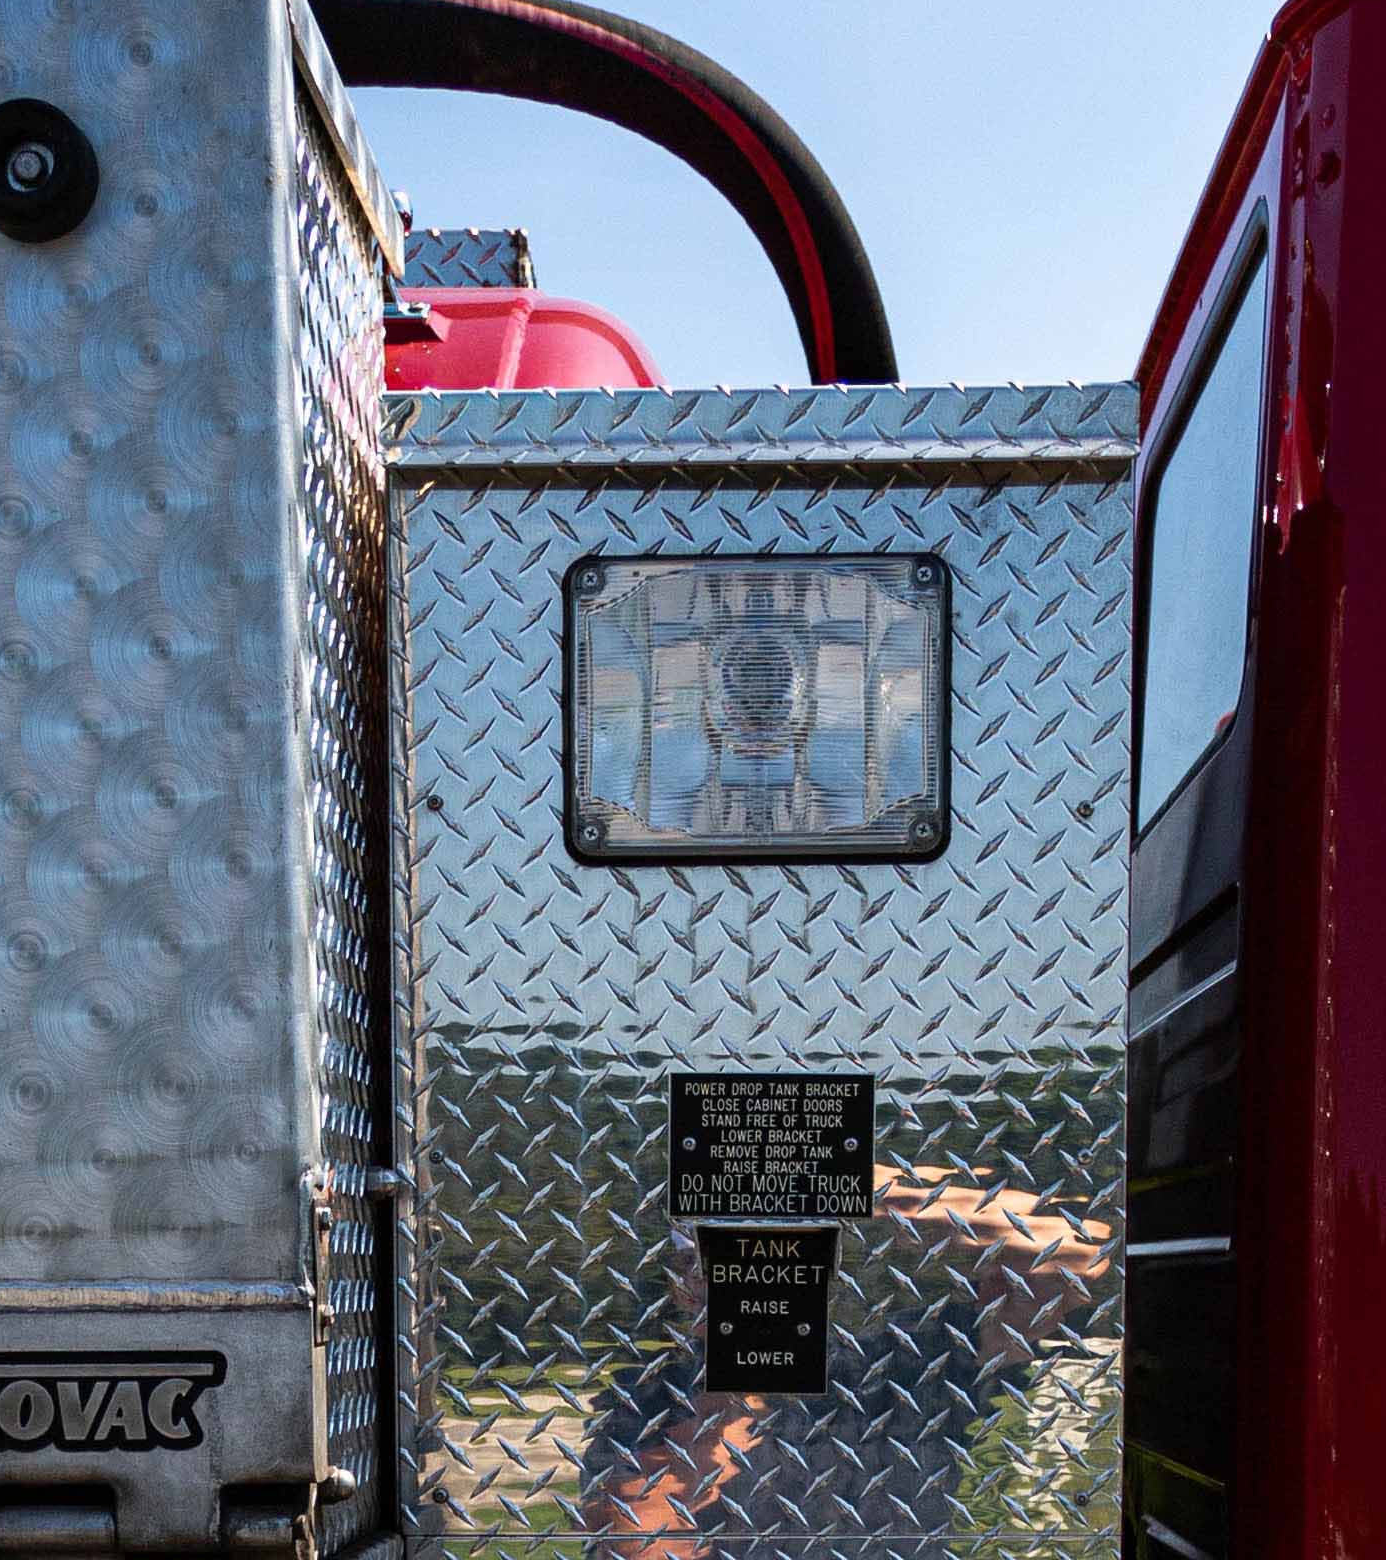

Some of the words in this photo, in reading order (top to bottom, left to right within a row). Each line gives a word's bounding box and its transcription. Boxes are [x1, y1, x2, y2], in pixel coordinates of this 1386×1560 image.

[685, 1082, 726, 1097] POWER
[731, 1082, 763, 1097] DROP
[769, 1082, 799, 1097] TANK
[805, 1082, 859, 1097] BRACKET
[702, 1098, 740, 1113] CLOSE
[746, 1098, 797, 1113] CABINET
[803, 1098, 843, 1113] DOORS
[701, 1113, 741, 1128] STAND
[746, 1113, 776, 1128] FREE
[782, 1113, 798, 1128] OF
[804, 1113, 843, 1128] TRUCK
[721, 1129, 763, 1144] LOWER
[768, 1129, 822, 1144] BRACKET
[710, 1145, 758, 1159] REMOVE
[765, 1145, 796, 1159] DROP
[802, 1145, 833, 1159] TANK
[724, 1160, 758, 1175] RAISE
[765, 1160, 818, 1175] BRACKET
[681, 1174, 704, 1194] DO
[711, 1174, 744, 1194] NOT
[752, 1174, 798, 1194] MOVE
[807, 1174, 861, 1194] TRUCK
[678, 1193, 721, 1213] WITH
[729, 1193, 808, 1213] BRACKET
[817, 1193, 867, 1213] DOWN
[736, 1239, 801, 1258] TANK
[712, 1264, 825, 1285] BRACKET
[740, 1300, 790, 1315] RAISE
[736, 1351, 795, 1365] LOWER
